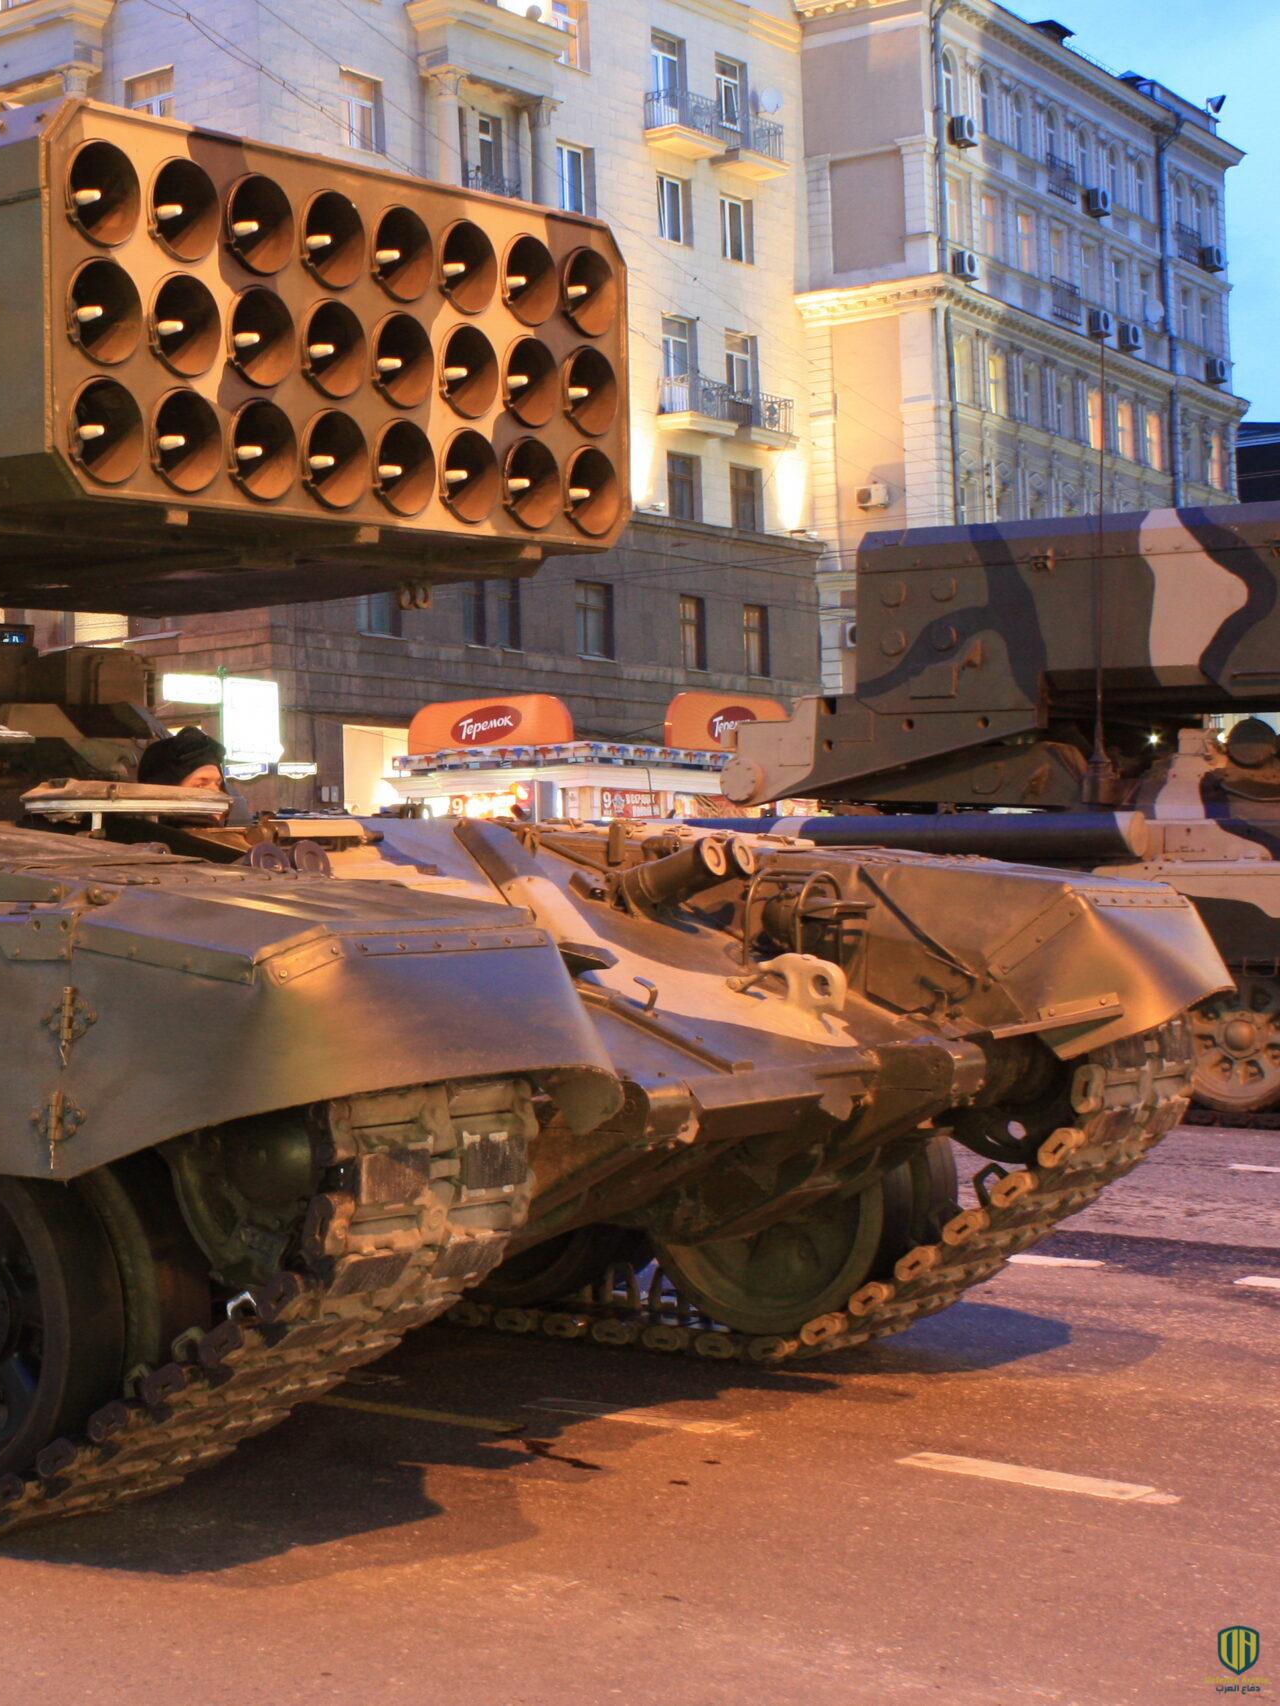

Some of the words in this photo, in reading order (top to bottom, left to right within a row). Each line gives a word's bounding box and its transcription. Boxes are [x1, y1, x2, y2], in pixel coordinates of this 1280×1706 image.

[459, 715, 514, 740] Теремок
[452, 798, 464, 816] 9
[603, 791, 612, 809] 9
